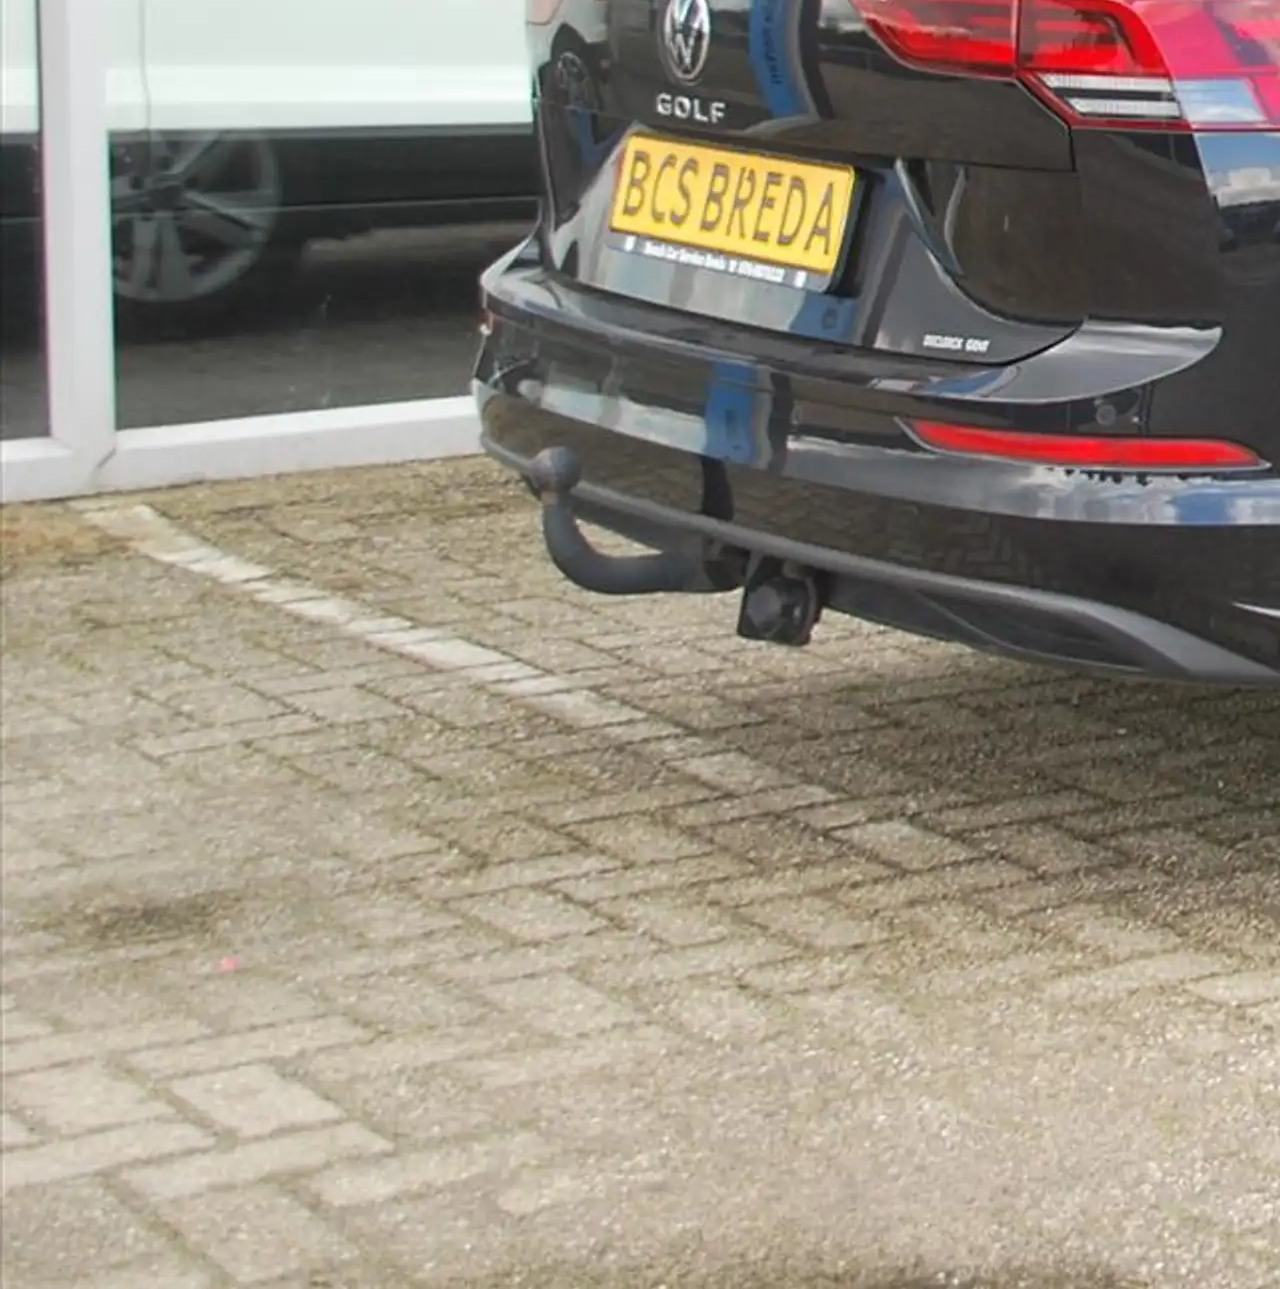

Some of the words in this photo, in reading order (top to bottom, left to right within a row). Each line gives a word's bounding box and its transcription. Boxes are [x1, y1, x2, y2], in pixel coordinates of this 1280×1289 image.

[655, 93, 727, 123] GOLF
[622, 150, 700, 227] BCS
[699, 162, 836, 256] BREDA
